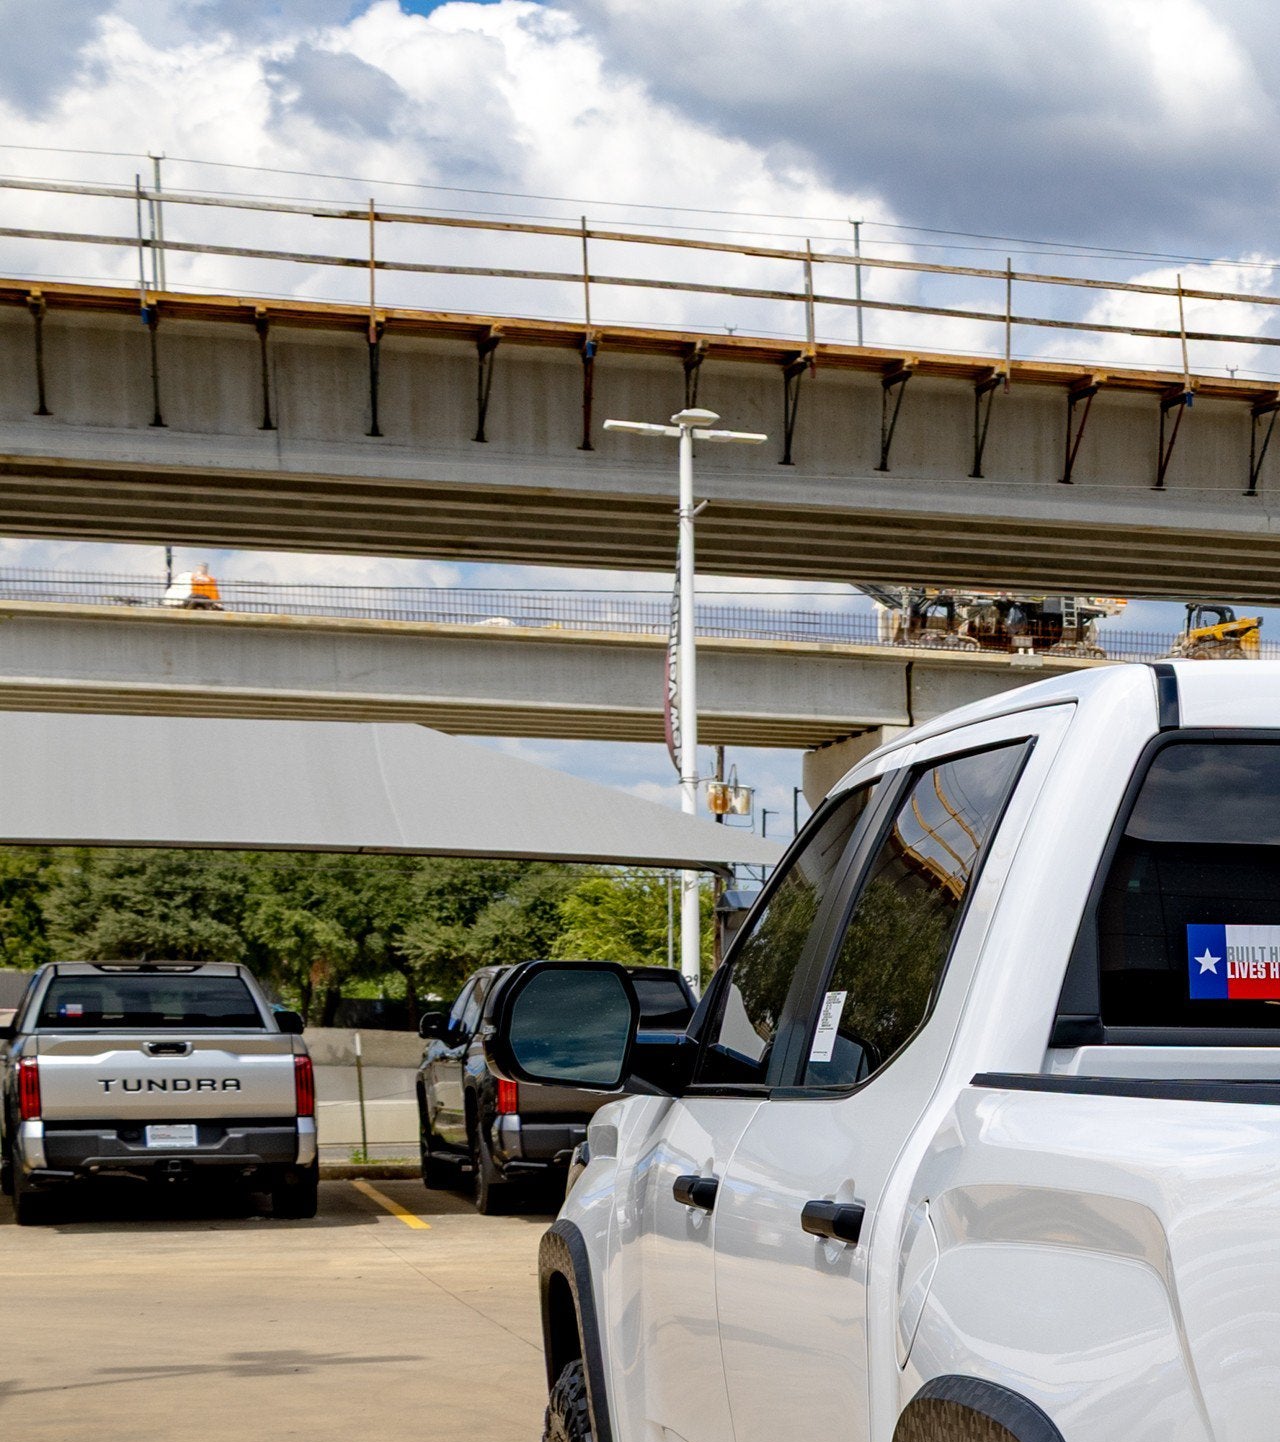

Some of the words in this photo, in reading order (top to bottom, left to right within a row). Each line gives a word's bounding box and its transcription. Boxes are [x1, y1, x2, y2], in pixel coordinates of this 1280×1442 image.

[1226, 946, 1266, 962] BUILT
[1227, 962, 1267, 979] LIVES
[98, 1078, 241, 1093] TUNDRA
